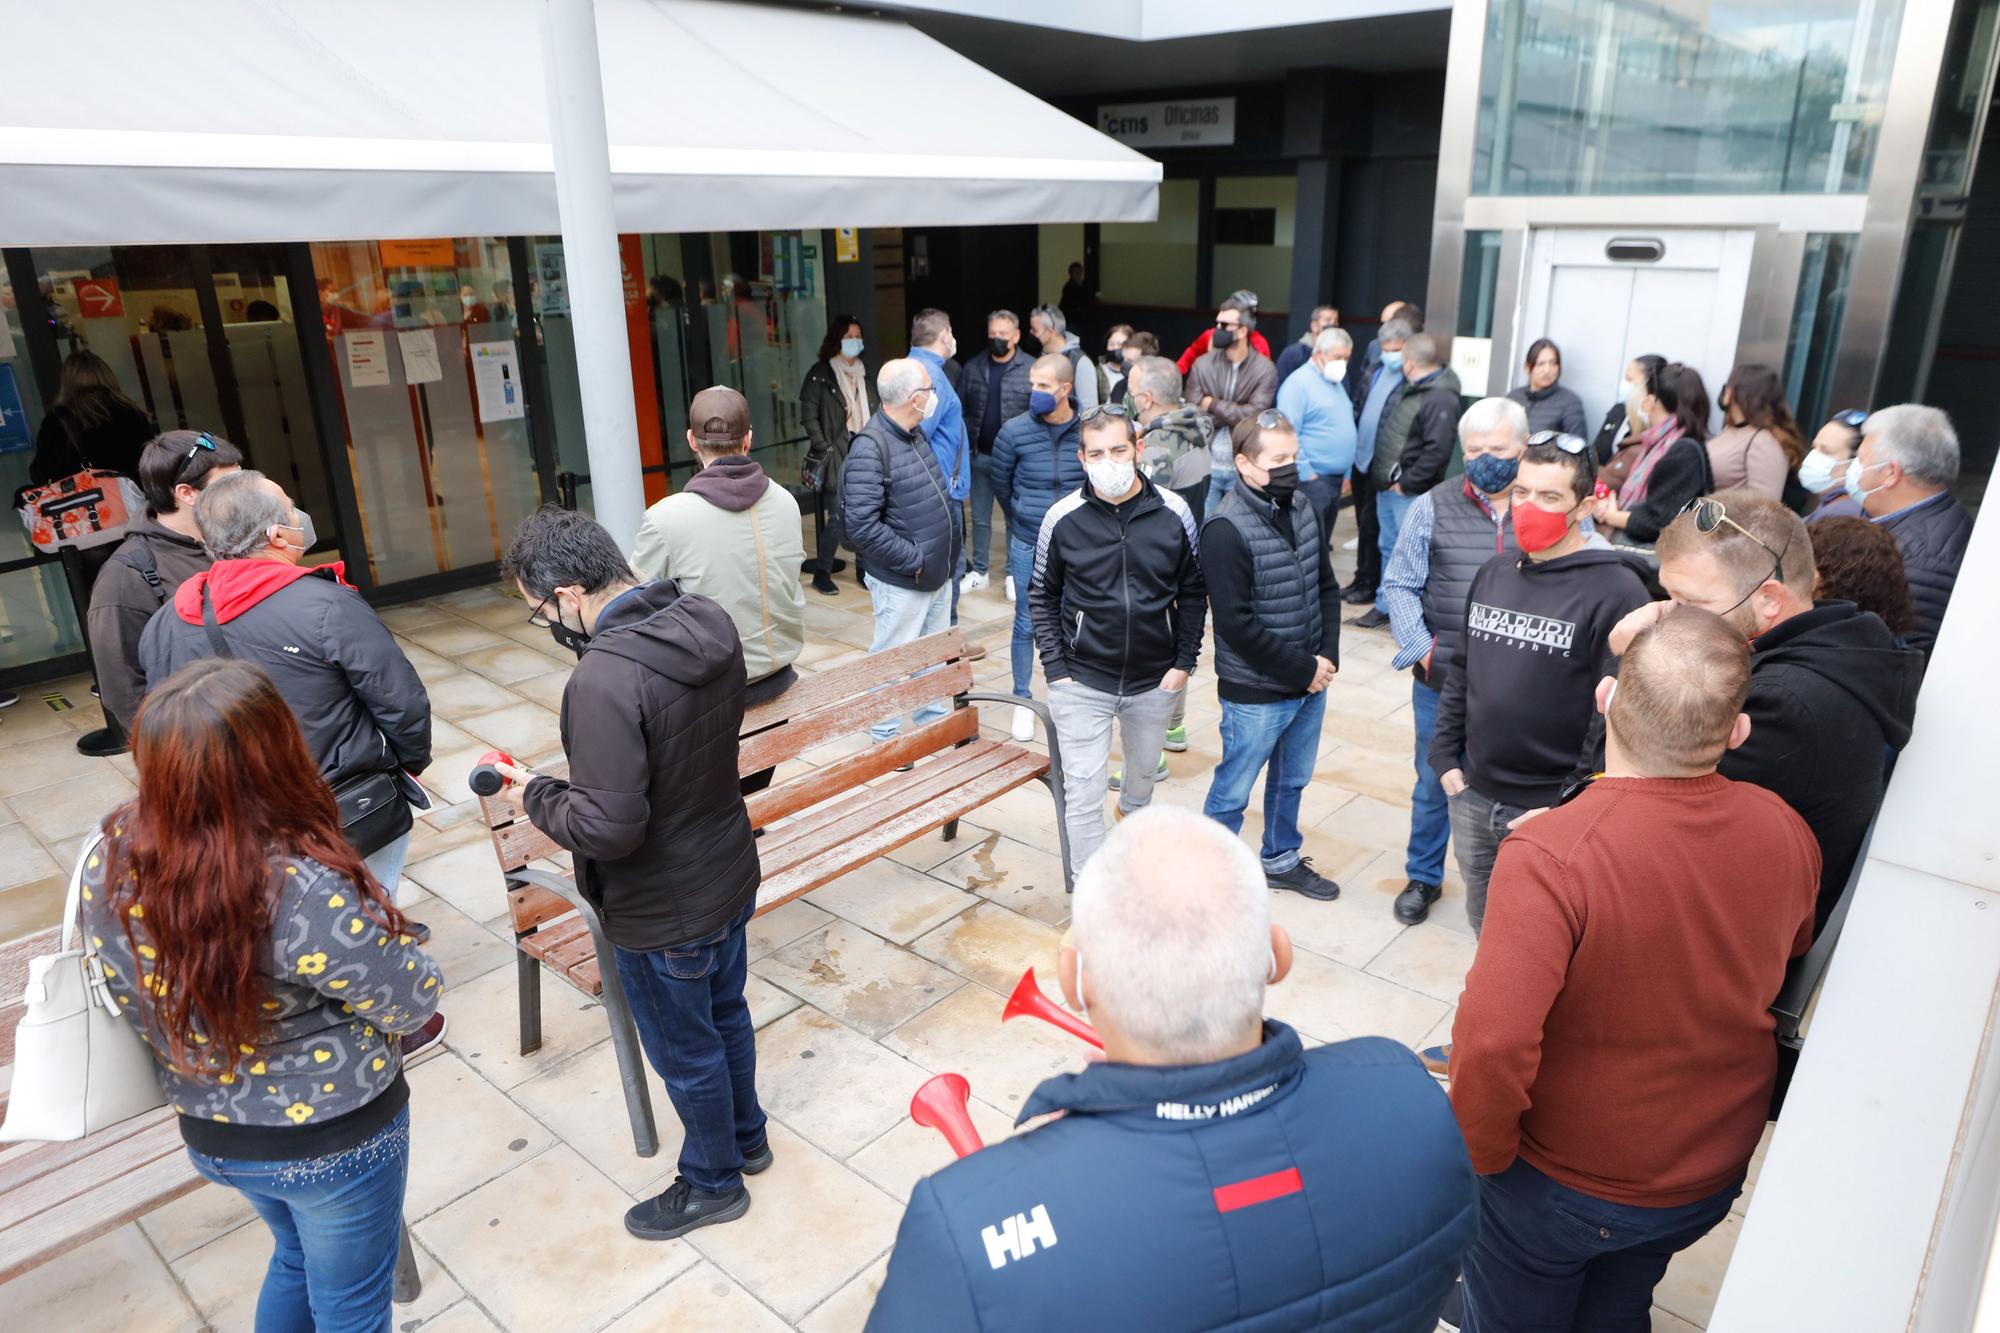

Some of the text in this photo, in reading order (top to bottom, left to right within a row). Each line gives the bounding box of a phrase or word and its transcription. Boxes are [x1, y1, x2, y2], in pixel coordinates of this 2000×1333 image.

[1165, 105, 1219, 126] Oficinas
[1108, 117, 1149, 135] CETIS
[1156, 1102, 1217, 1120] HELLY
[981, 1203, 1058, 1270] HH
